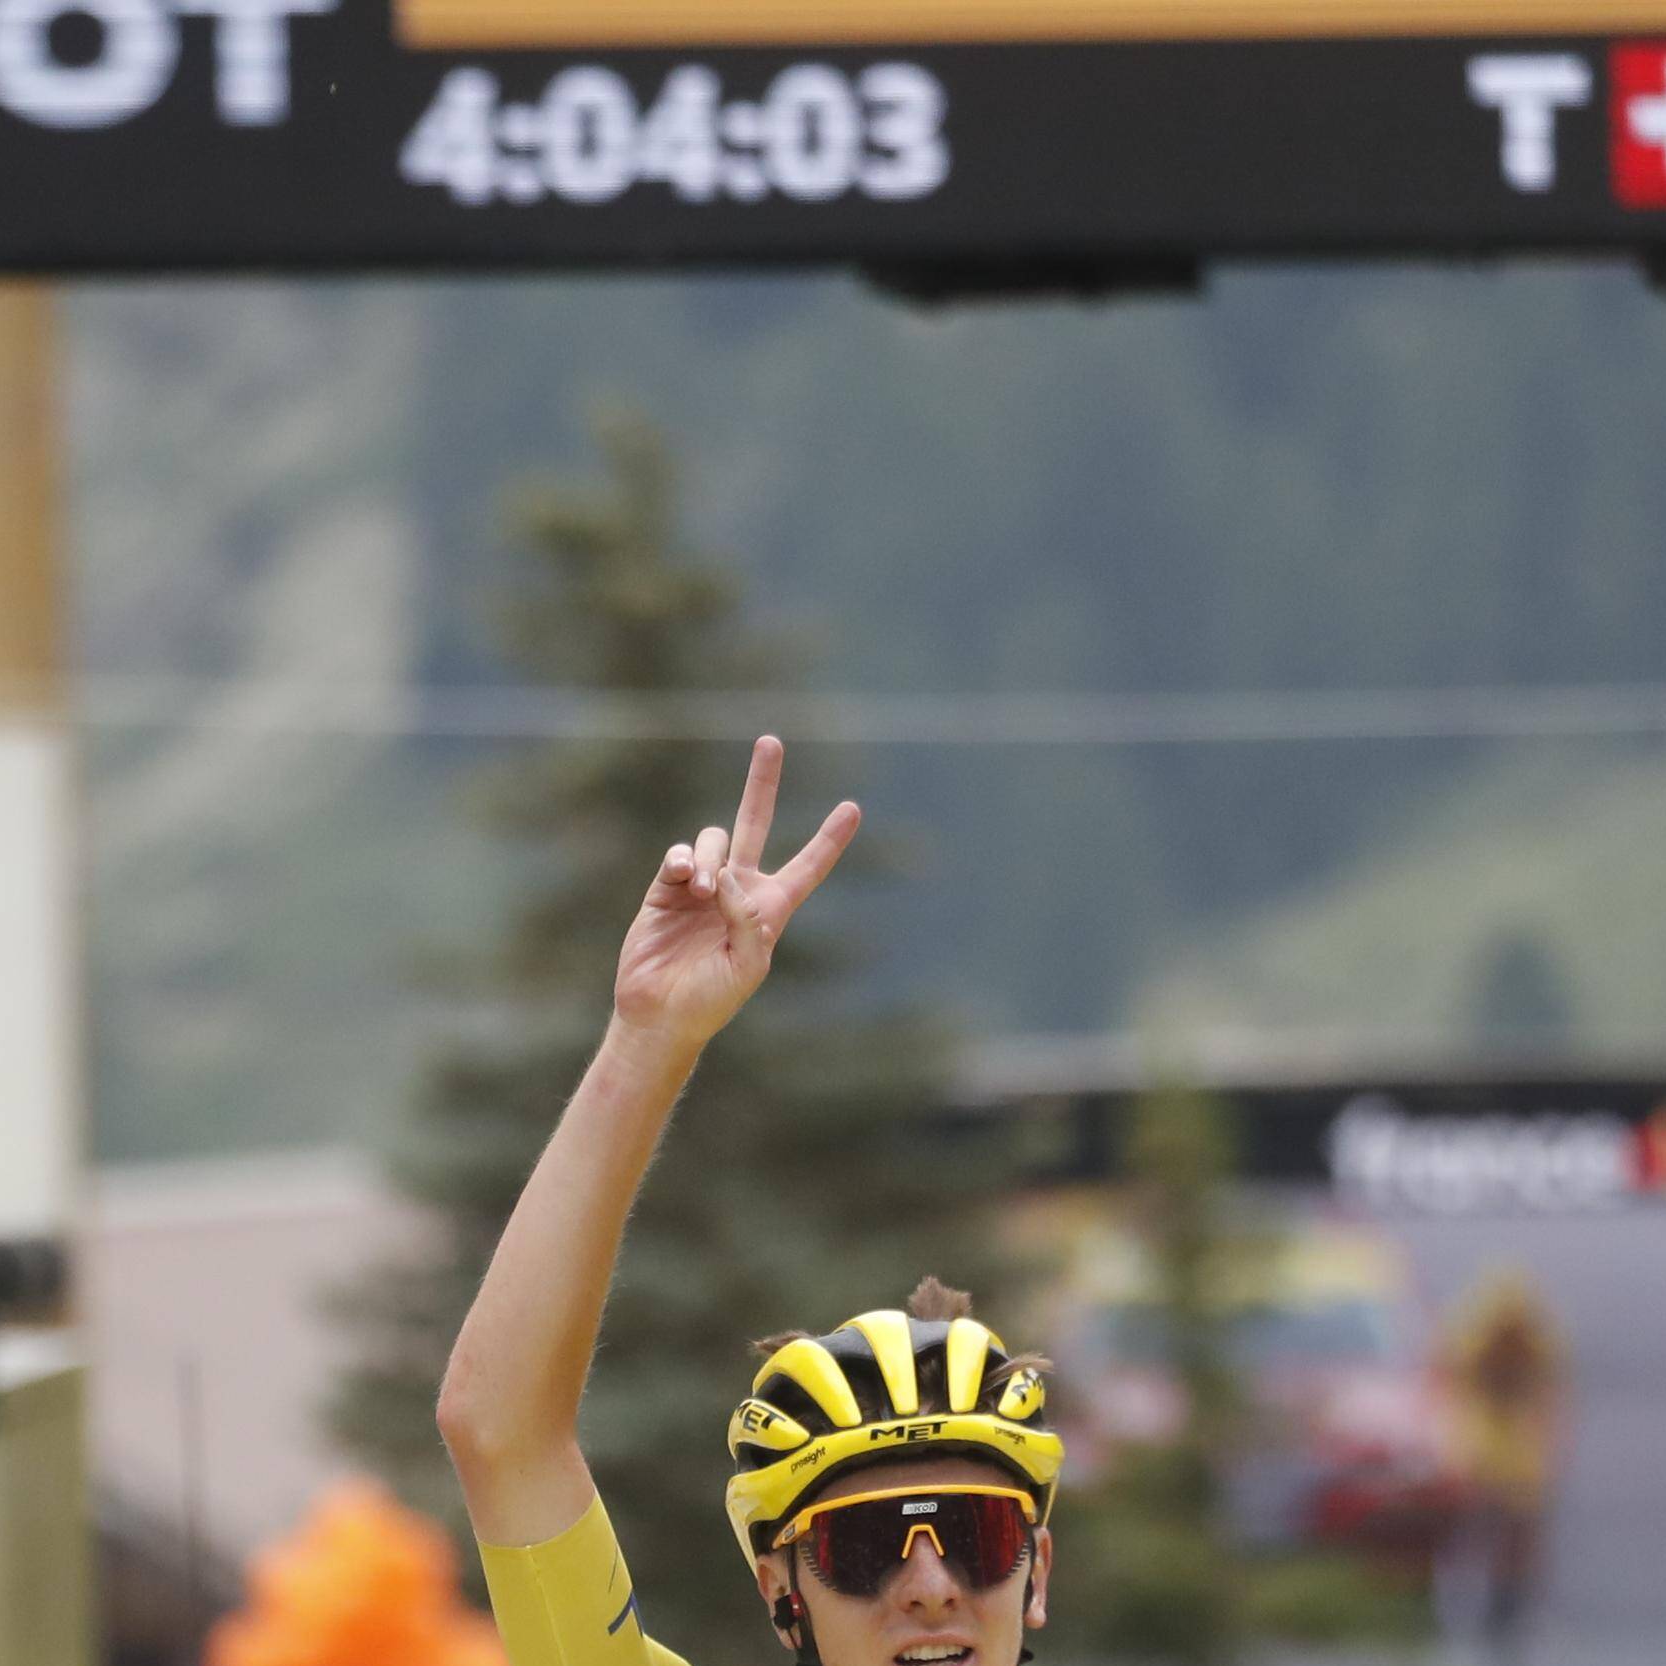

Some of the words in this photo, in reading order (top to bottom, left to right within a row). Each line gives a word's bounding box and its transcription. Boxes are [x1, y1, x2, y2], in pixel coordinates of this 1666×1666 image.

[398, 62, 950, 204] 4:04:03
[1467, 55, 1589, 192] T
[869, 1421, 948, 1443] MET
